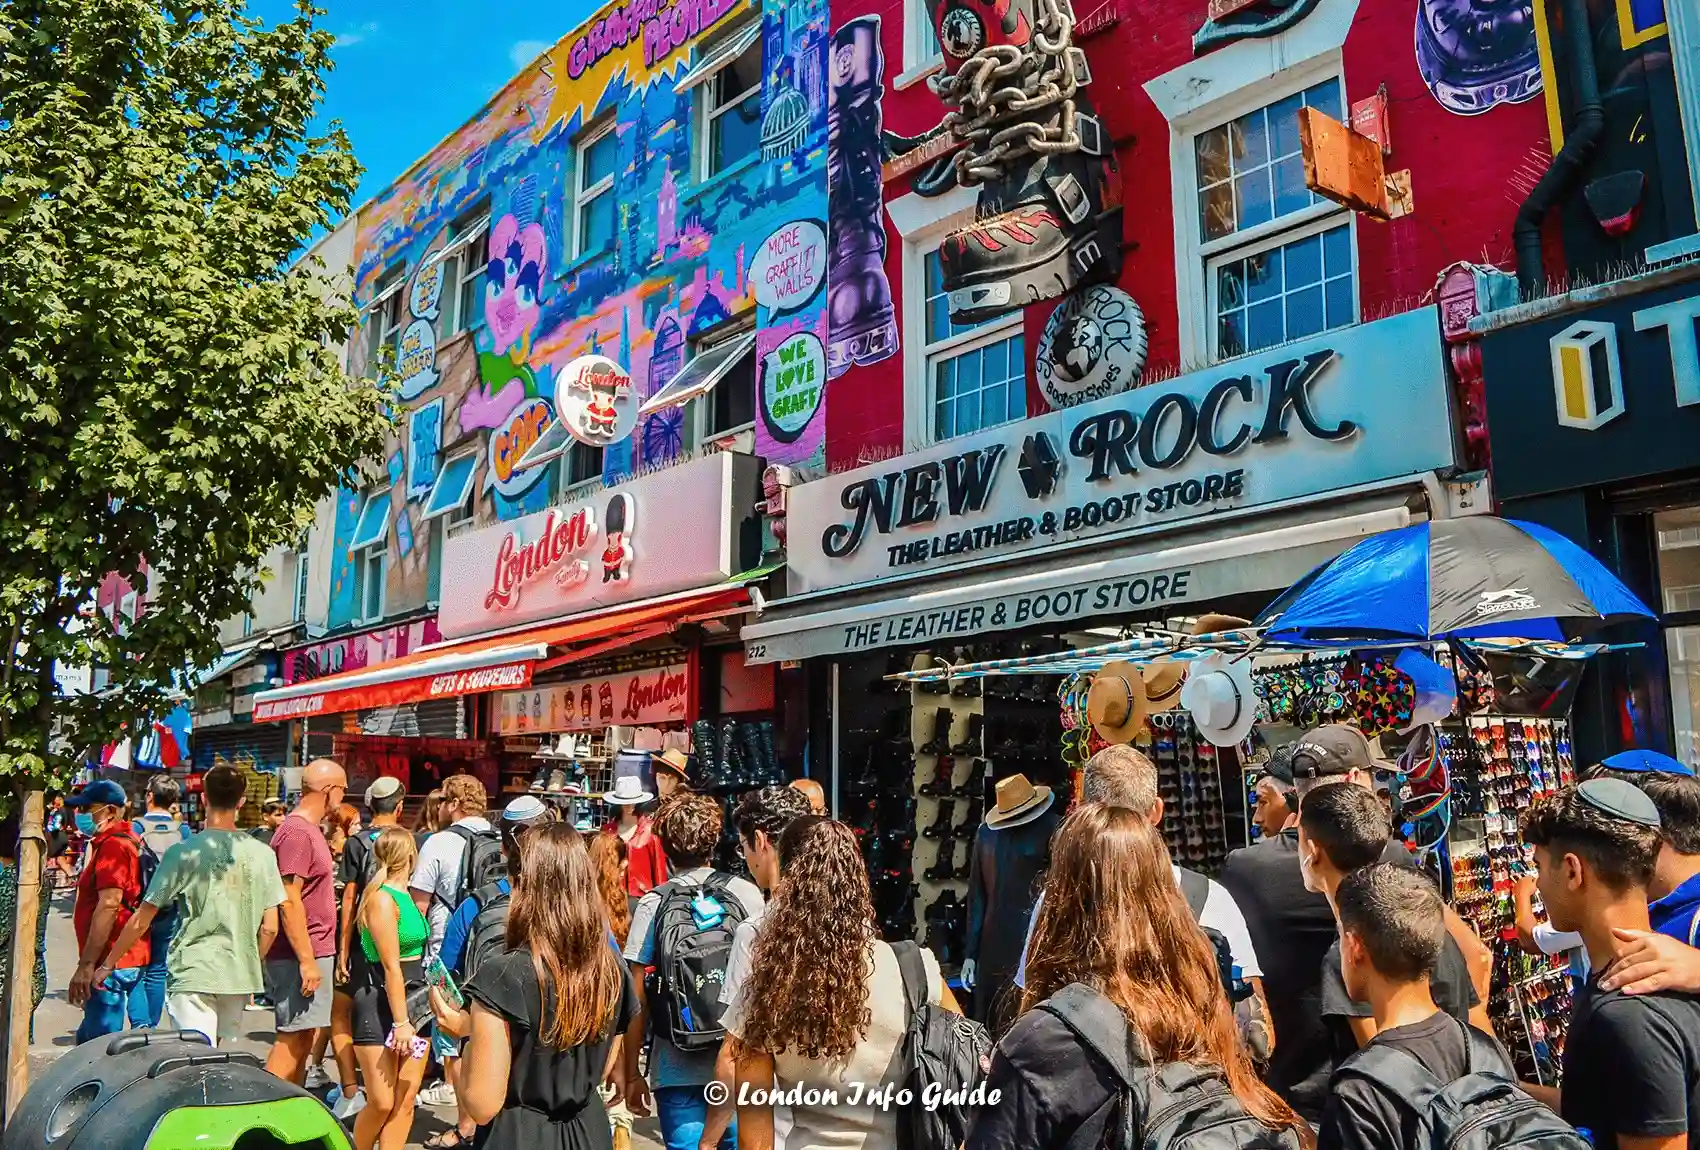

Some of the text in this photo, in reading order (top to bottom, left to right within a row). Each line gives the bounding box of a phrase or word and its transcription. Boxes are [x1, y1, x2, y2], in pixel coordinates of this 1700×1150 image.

[768, 226, 800, 261] MORE
[1086, 287, 1132, 361] ROCK
[779, 339, 808, 366] WE
[575, 364, 633, 391] London
[771, 387, 818, 420] GRAFF
[822, 348, 1357, 558] NEW ROCK
[887, 468, 1245, 567] THE LEATHER & BOOT STORE
[484, 507, 592, 611] London
[844, 570, 1191, 648] THE LEATHER & BOOT STORE
[749, 645, 766, 659] 212
[430, 674, 458, 696] GIFTS
[466, 664, 527, 690] SOUVENIRS
[621, 669, 687, 721] London
